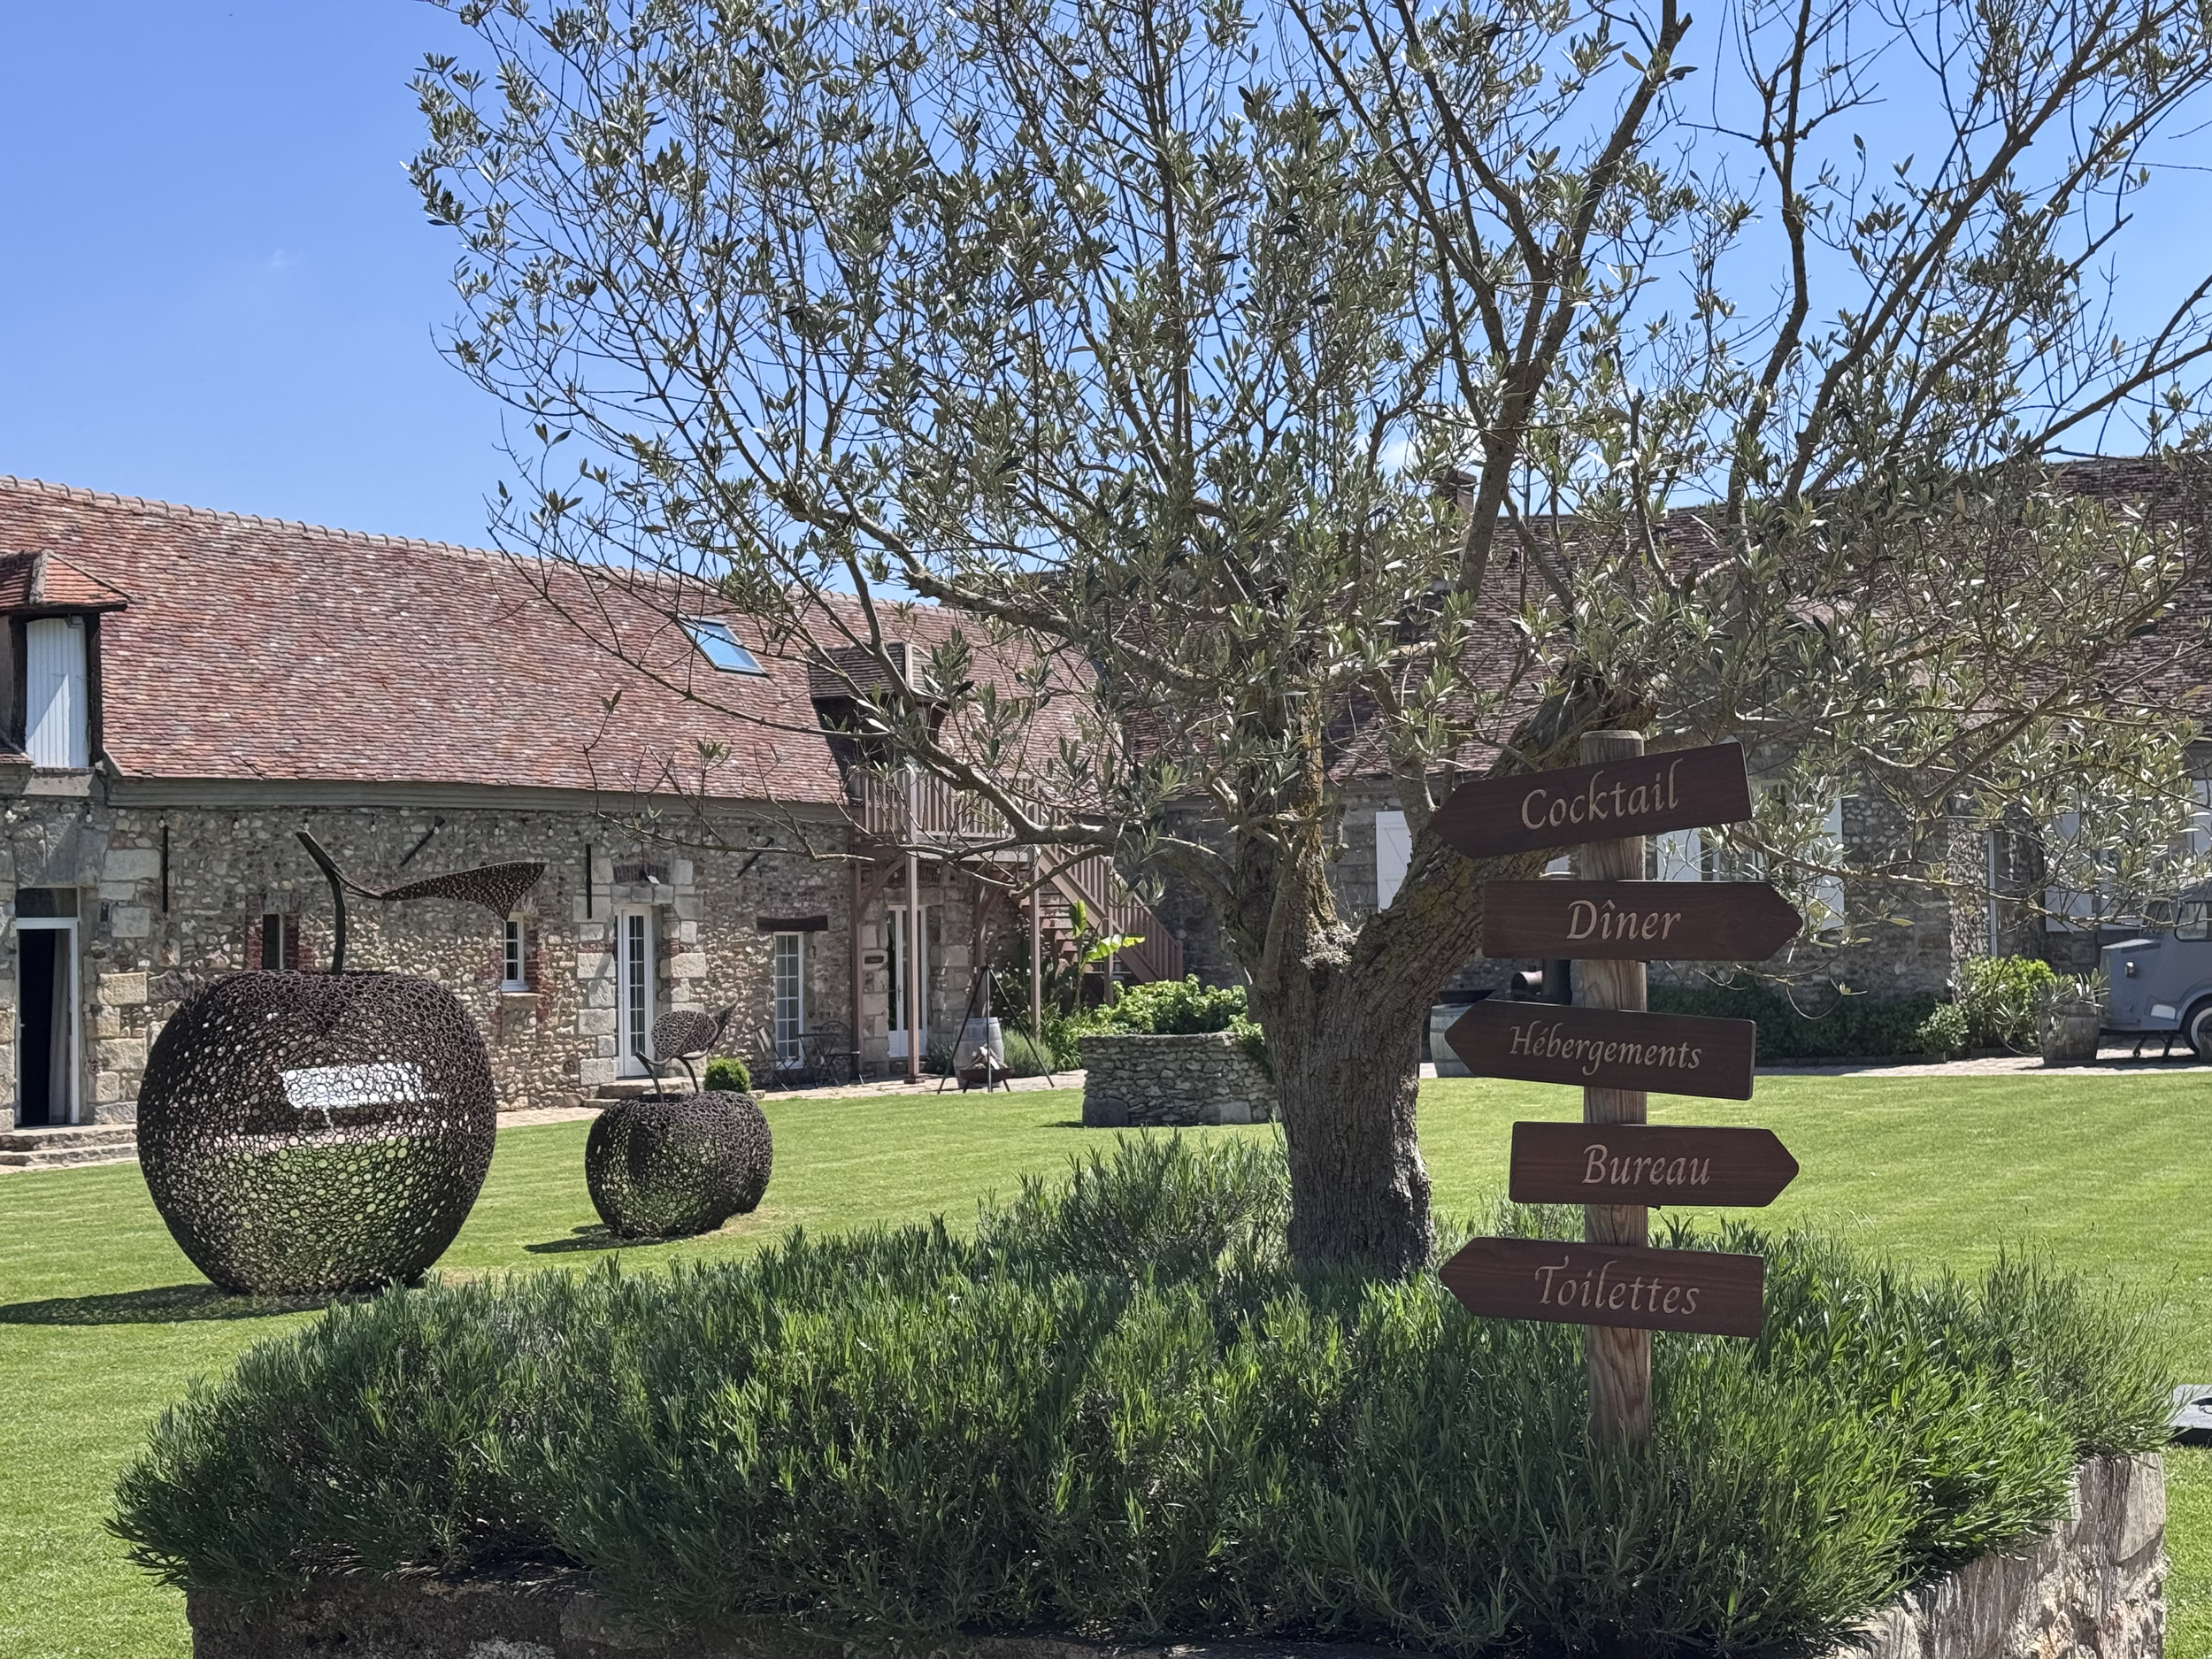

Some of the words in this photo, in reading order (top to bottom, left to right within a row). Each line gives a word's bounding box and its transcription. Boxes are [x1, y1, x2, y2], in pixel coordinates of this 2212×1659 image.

[1522, 758, 1684, 829] Cocktail
[1567, 899, 1681, 940] Dîner
[1509, 1020, 1701, 1076] Hébergements
[1583, 1144, 1710, 1186] Bureau
[1535, 1256, 1700, 1315] Toilettes
